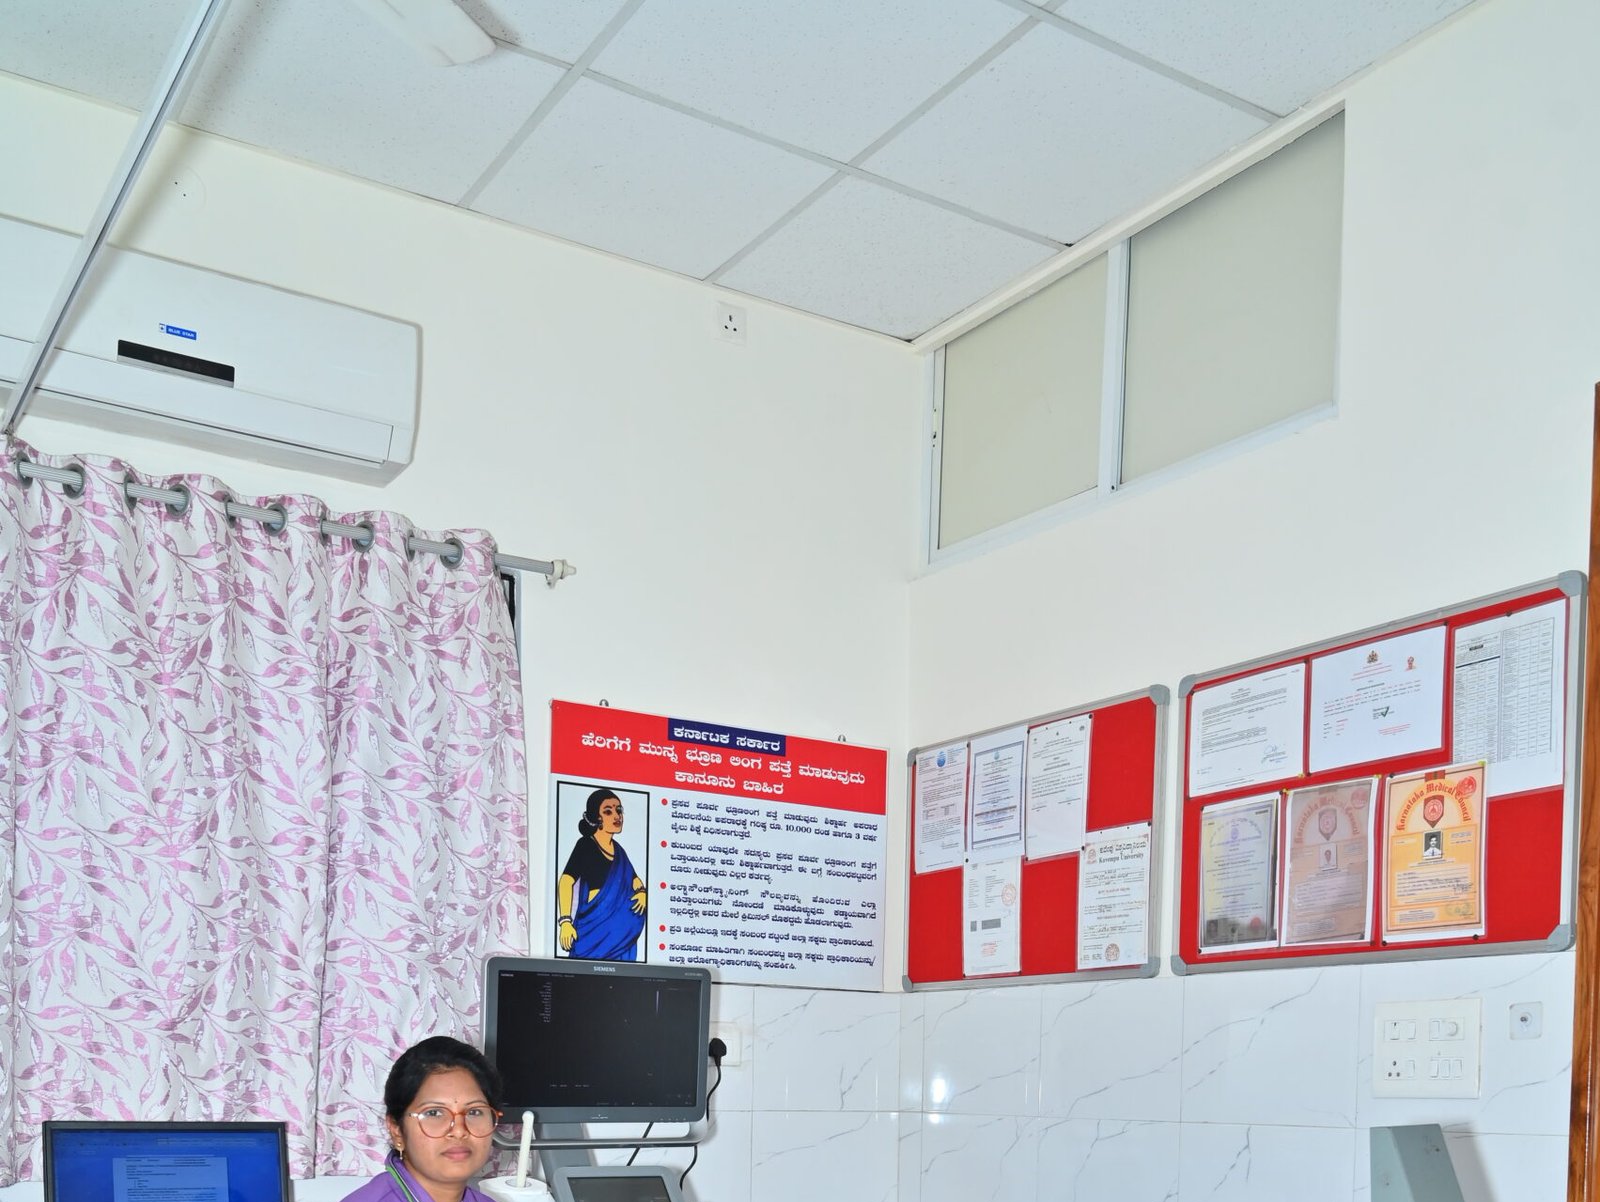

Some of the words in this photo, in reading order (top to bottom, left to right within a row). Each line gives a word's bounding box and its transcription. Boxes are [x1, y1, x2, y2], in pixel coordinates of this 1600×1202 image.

[674, 726, 729, 744] ಕರ್ನಾಟಕ
[737, 735, 780, 751] ಸರ್ಕಾರ
[582, 732, 631, 752] ಹೆರಿಗೆಗೆ
[639, 741, 678, 763] ಮುನ್ನ
[686, 749, 722, 766] ಭ್ರೂಣ
[730, 754, 762, 770] ಲಿಂಗ
[769, 760, 791, 778] ಪತ್ತೆ
[799, 764, 865, 785] ಮಾಡುವುದು
[675, 770, 735, 788] ಕಾನೂನು
[743, 779, 784, 794] ಬಾಹಿರ
[1396, 790, 1424, 830] Karnataka
[1426, 783, 1456, 795] Medical
